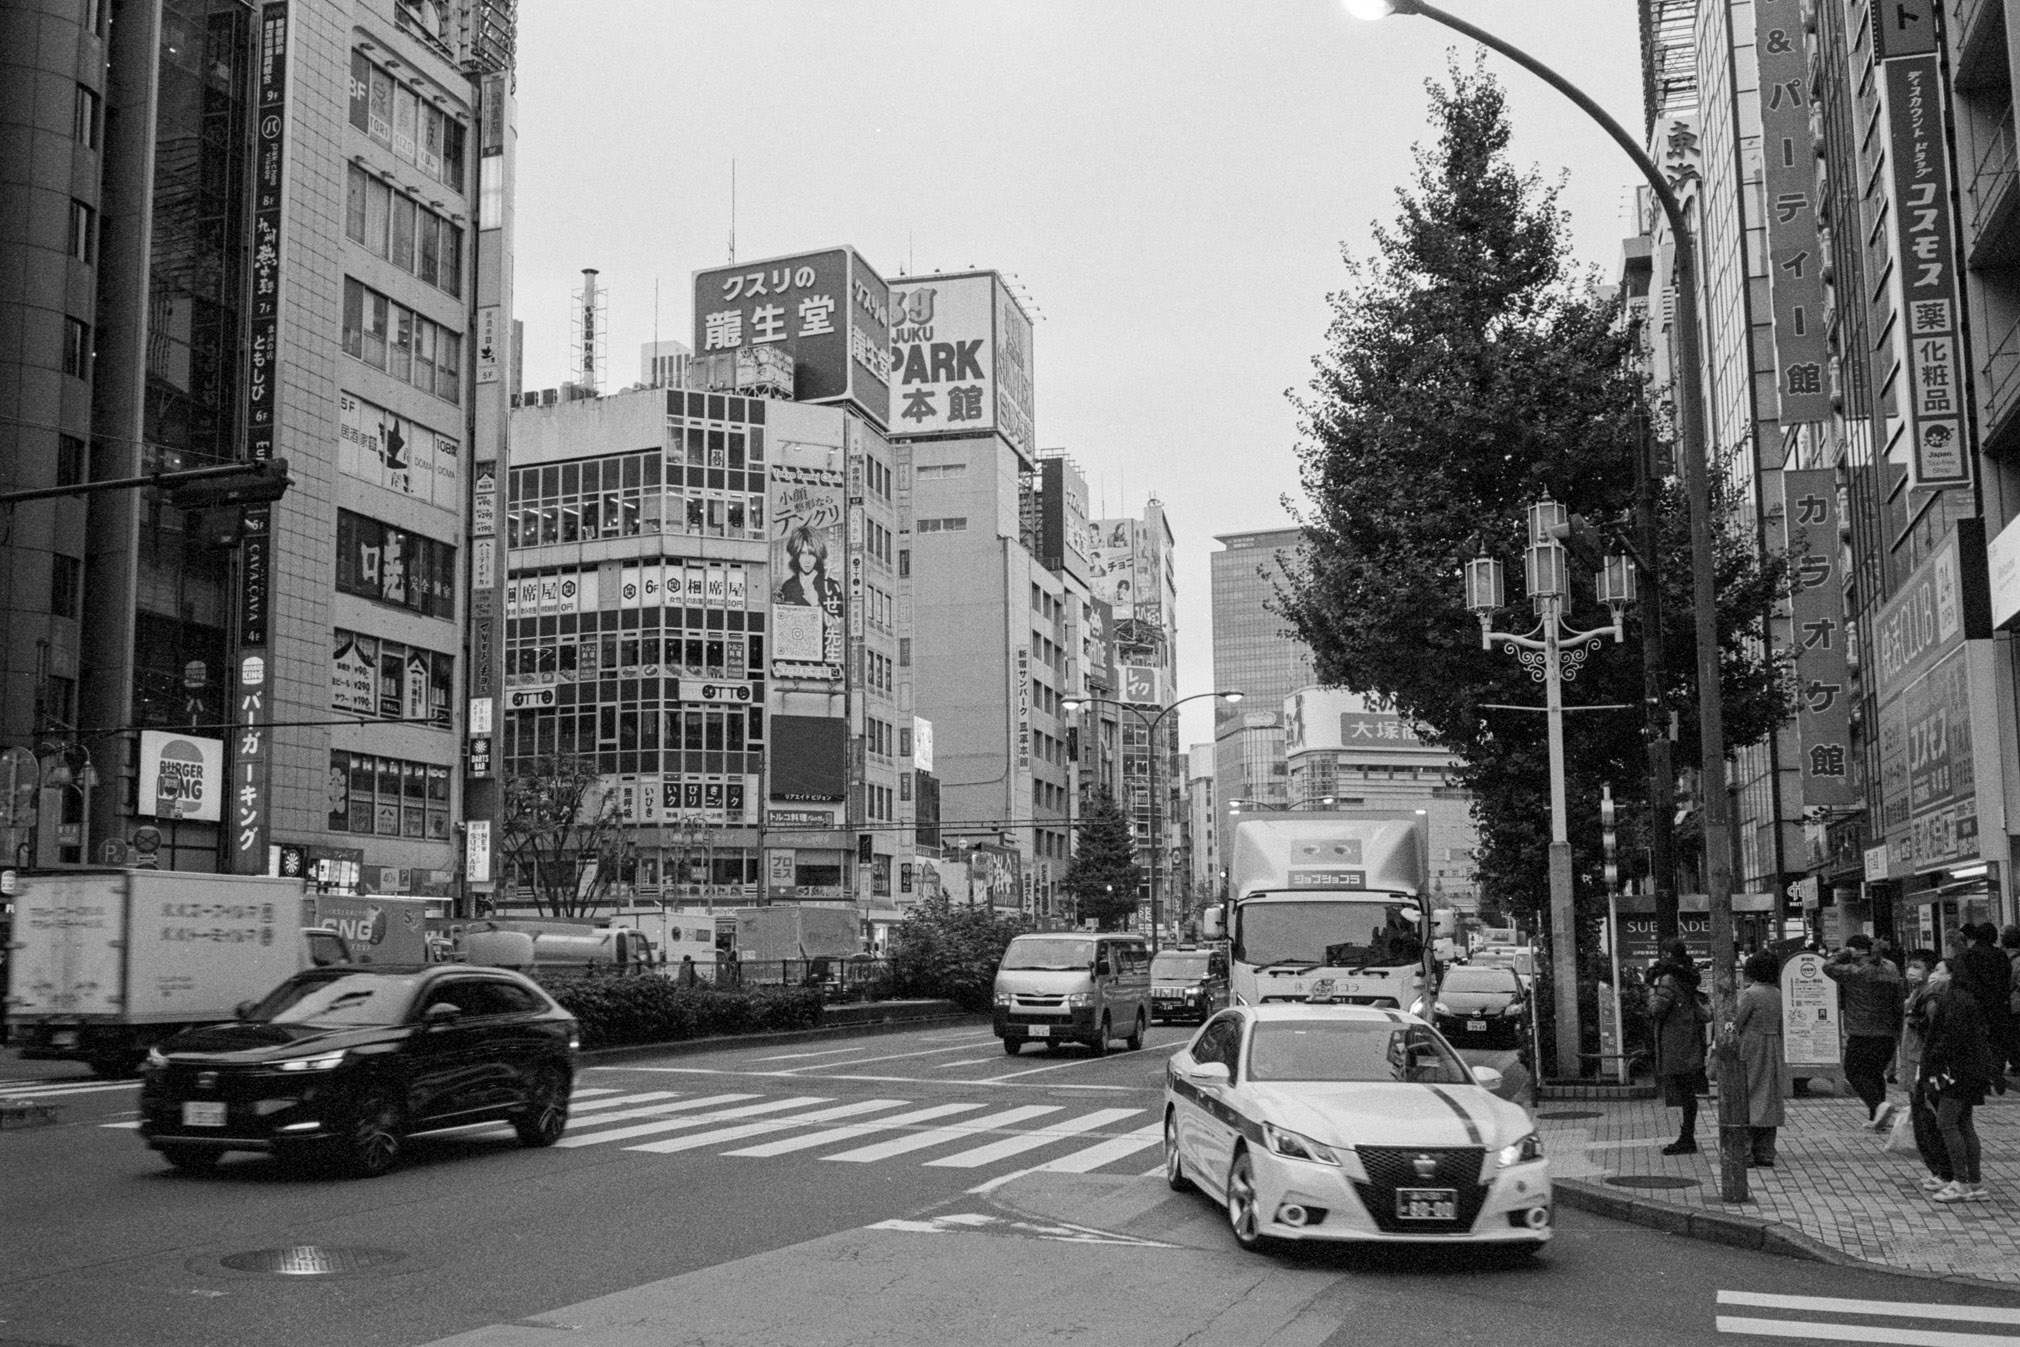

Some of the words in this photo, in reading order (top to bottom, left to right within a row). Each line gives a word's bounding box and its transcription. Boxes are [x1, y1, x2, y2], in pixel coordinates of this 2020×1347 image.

[267, 91, 279, 101] 9F
[263, 196, 274, 206] 8F
[1907, 183, 1942, 287] コスモス
[722, 266, 816, 301] クスリの
[259, 303, 271, 313] 7F
[1915, 302, 1946, 330] 薬
[704, 294, 835, 350] 龍生堂
[250, 335, 266, 401] ともしび
[1920, 340, 1951, 412] 化粧品
[340, 397, 355, 413] 5F
[901, 384, 983, 424] 本館
[256, 410, 267, 421] 6F
[645, 579, 659, 594] 6F
[249, 630, 261, 641] 4F
[1797, 494, 1847, 778] カラオケ館
[1018, 649, 1028, 716] 新宿サンパーク
[1128, 669, 1150, 696] レイク
[1018, 722, 1029, 767] 三平本館
[471, 754, 489, 763] DARTS
[474, 763, 486, 771] BAR
[160, 760, 204, 779] BURGER
[240, 690, 263, 850] バーガーキング
[667, 785, 740, 797] いびきの
[623, 788, 633, 819] 無呼吸
[644, 787, 655, 818] いびき
[667, 795, 740, 807] クリニック
[769, 813, 808, 822] トルコ料理
[772, 857, 793, 867] プロ
[772, 868, 793, 879] ミス
